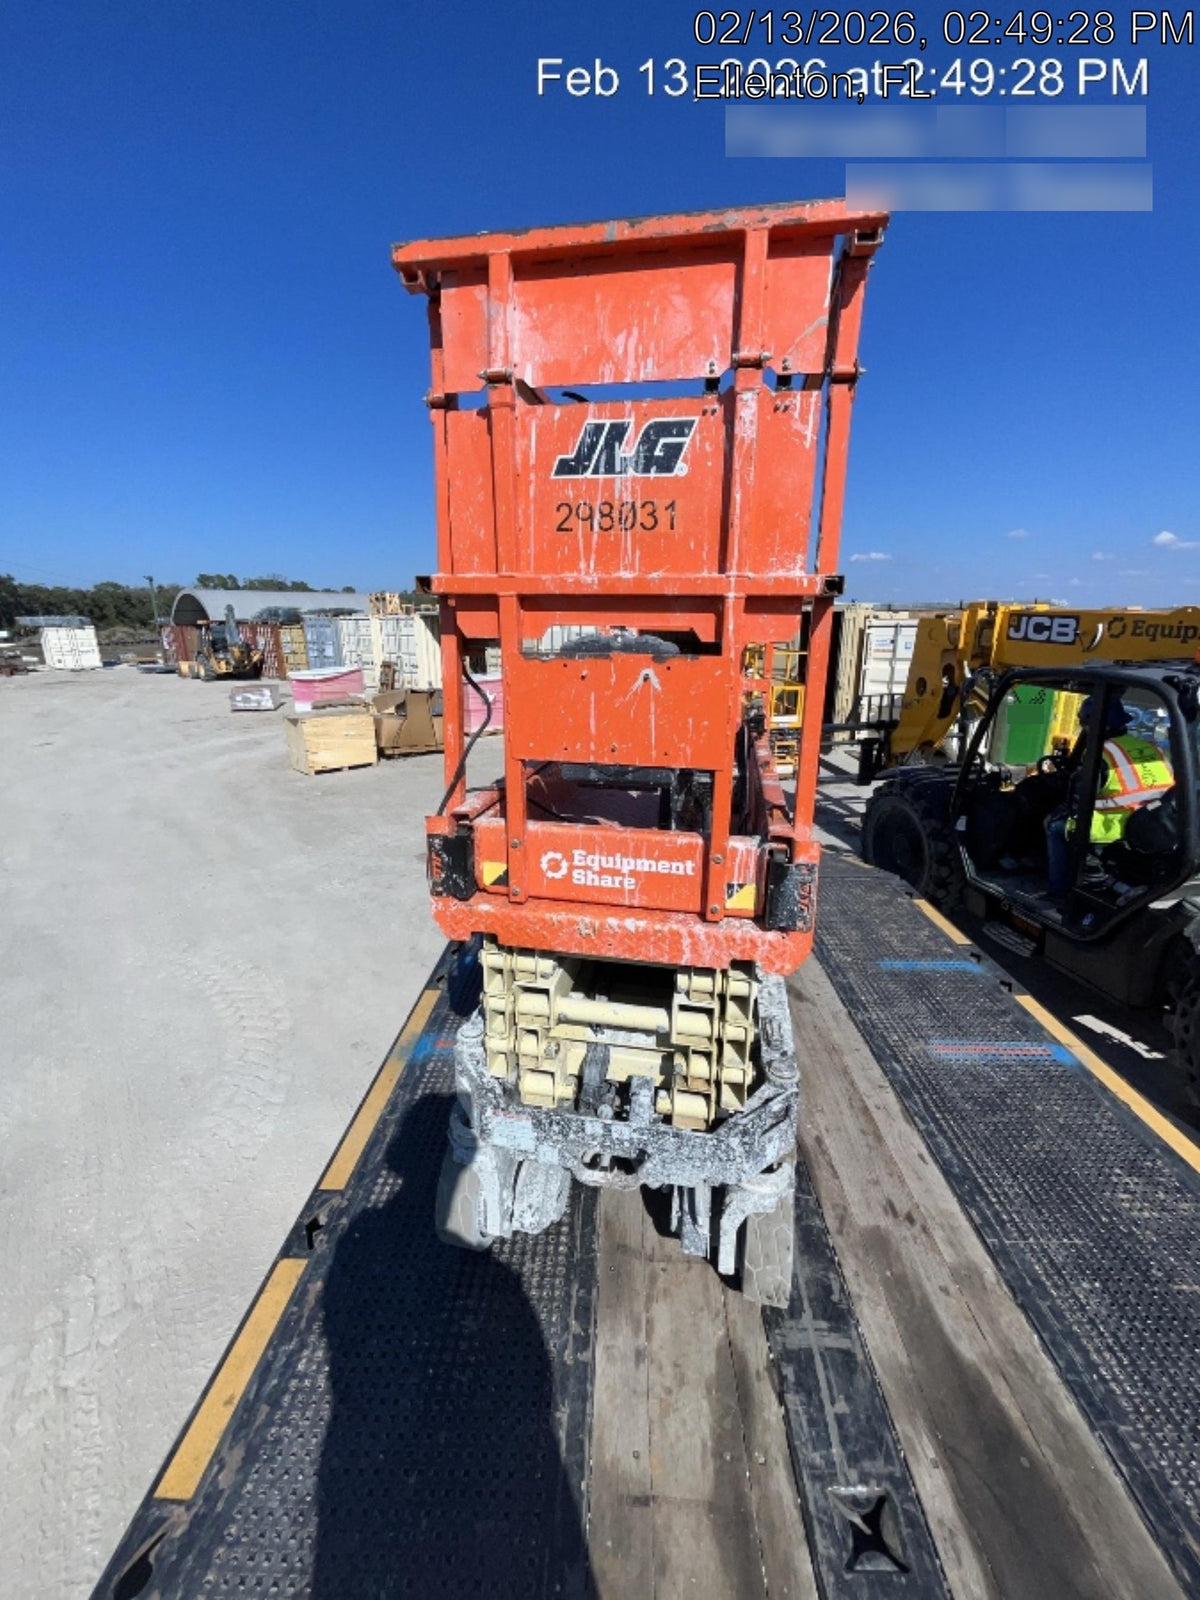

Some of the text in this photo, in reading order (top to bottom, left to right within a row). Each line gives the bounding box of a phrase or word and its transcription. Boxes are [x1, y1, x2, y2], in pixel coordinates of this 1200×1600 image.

[556, 500, 676, 532] 298031
[1008, 616, 1077, 643] JCB
[1131, 619, 1200, 644] Equip
[572, 849, 695, 876] Equipment
[572, 868, 636, 890] Share
